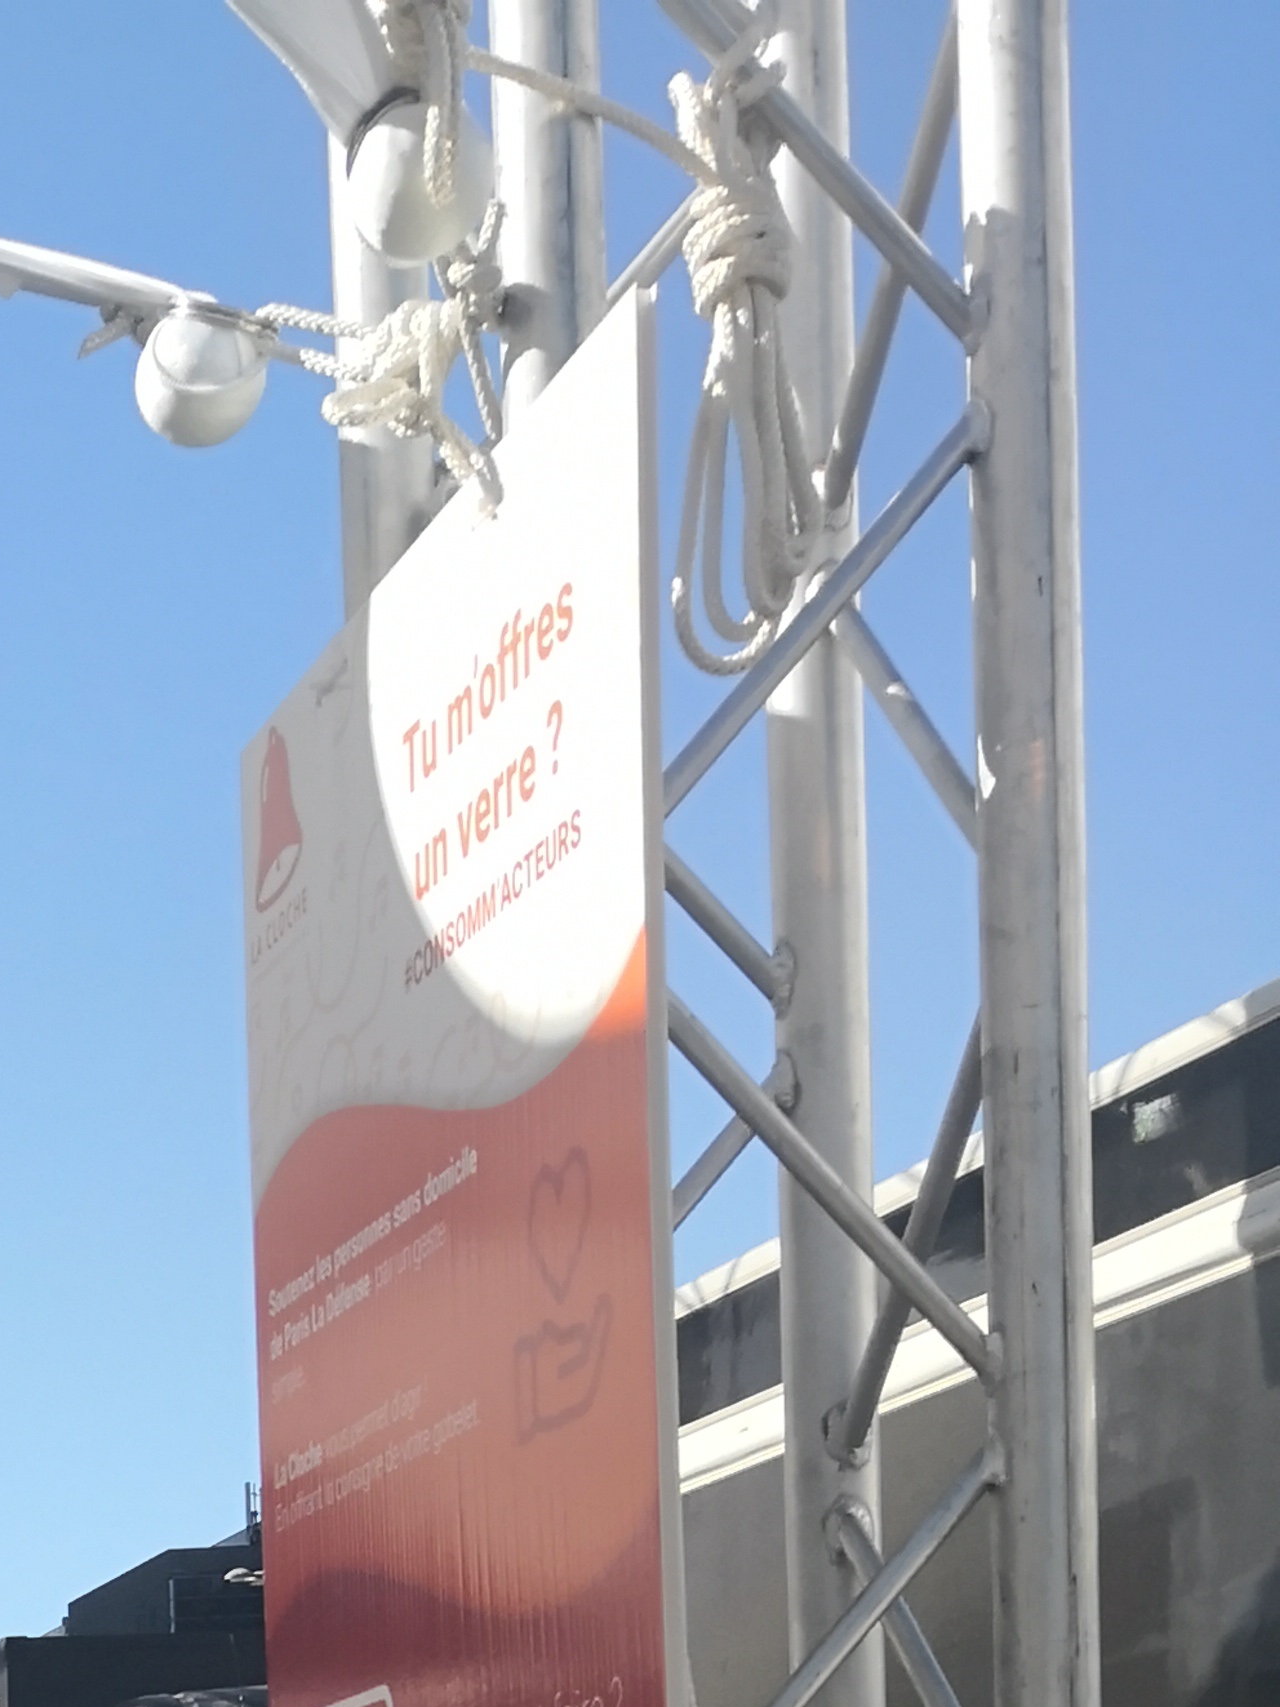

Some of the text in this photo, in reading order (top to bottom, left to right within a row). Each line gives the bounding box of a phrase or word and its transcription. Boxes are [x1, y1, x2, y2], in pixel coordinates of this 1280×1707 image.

[402, 582, 574, 793] Tu m'offres
[414, 699, 563, 901] un verre ?
[250, 886, 308, 965] LA CLOCHE
[404, 808, 582, 994] #CONSOMM'ACTEURS
[268, 1145, 478, 1318] Soutenez les personnes sans domicile
[269, 1330, 283, 1361] de
[283, 1311, 310, 1351] Paris
[311, 1303, 325, 1333] La
[326, 1272, 371, 1323] Défense
[413, 1220, 446, 1272] geste
[273, 1462, 287, 1490] La
[287, 1439, 323, 1481] Cloche
[324, 1427, 349, 1458] vous
[350, 1399, 389, 1449] permet
[335, 1453, 384, 1501] consigne
[402, 1428, 432, 1462] votre
